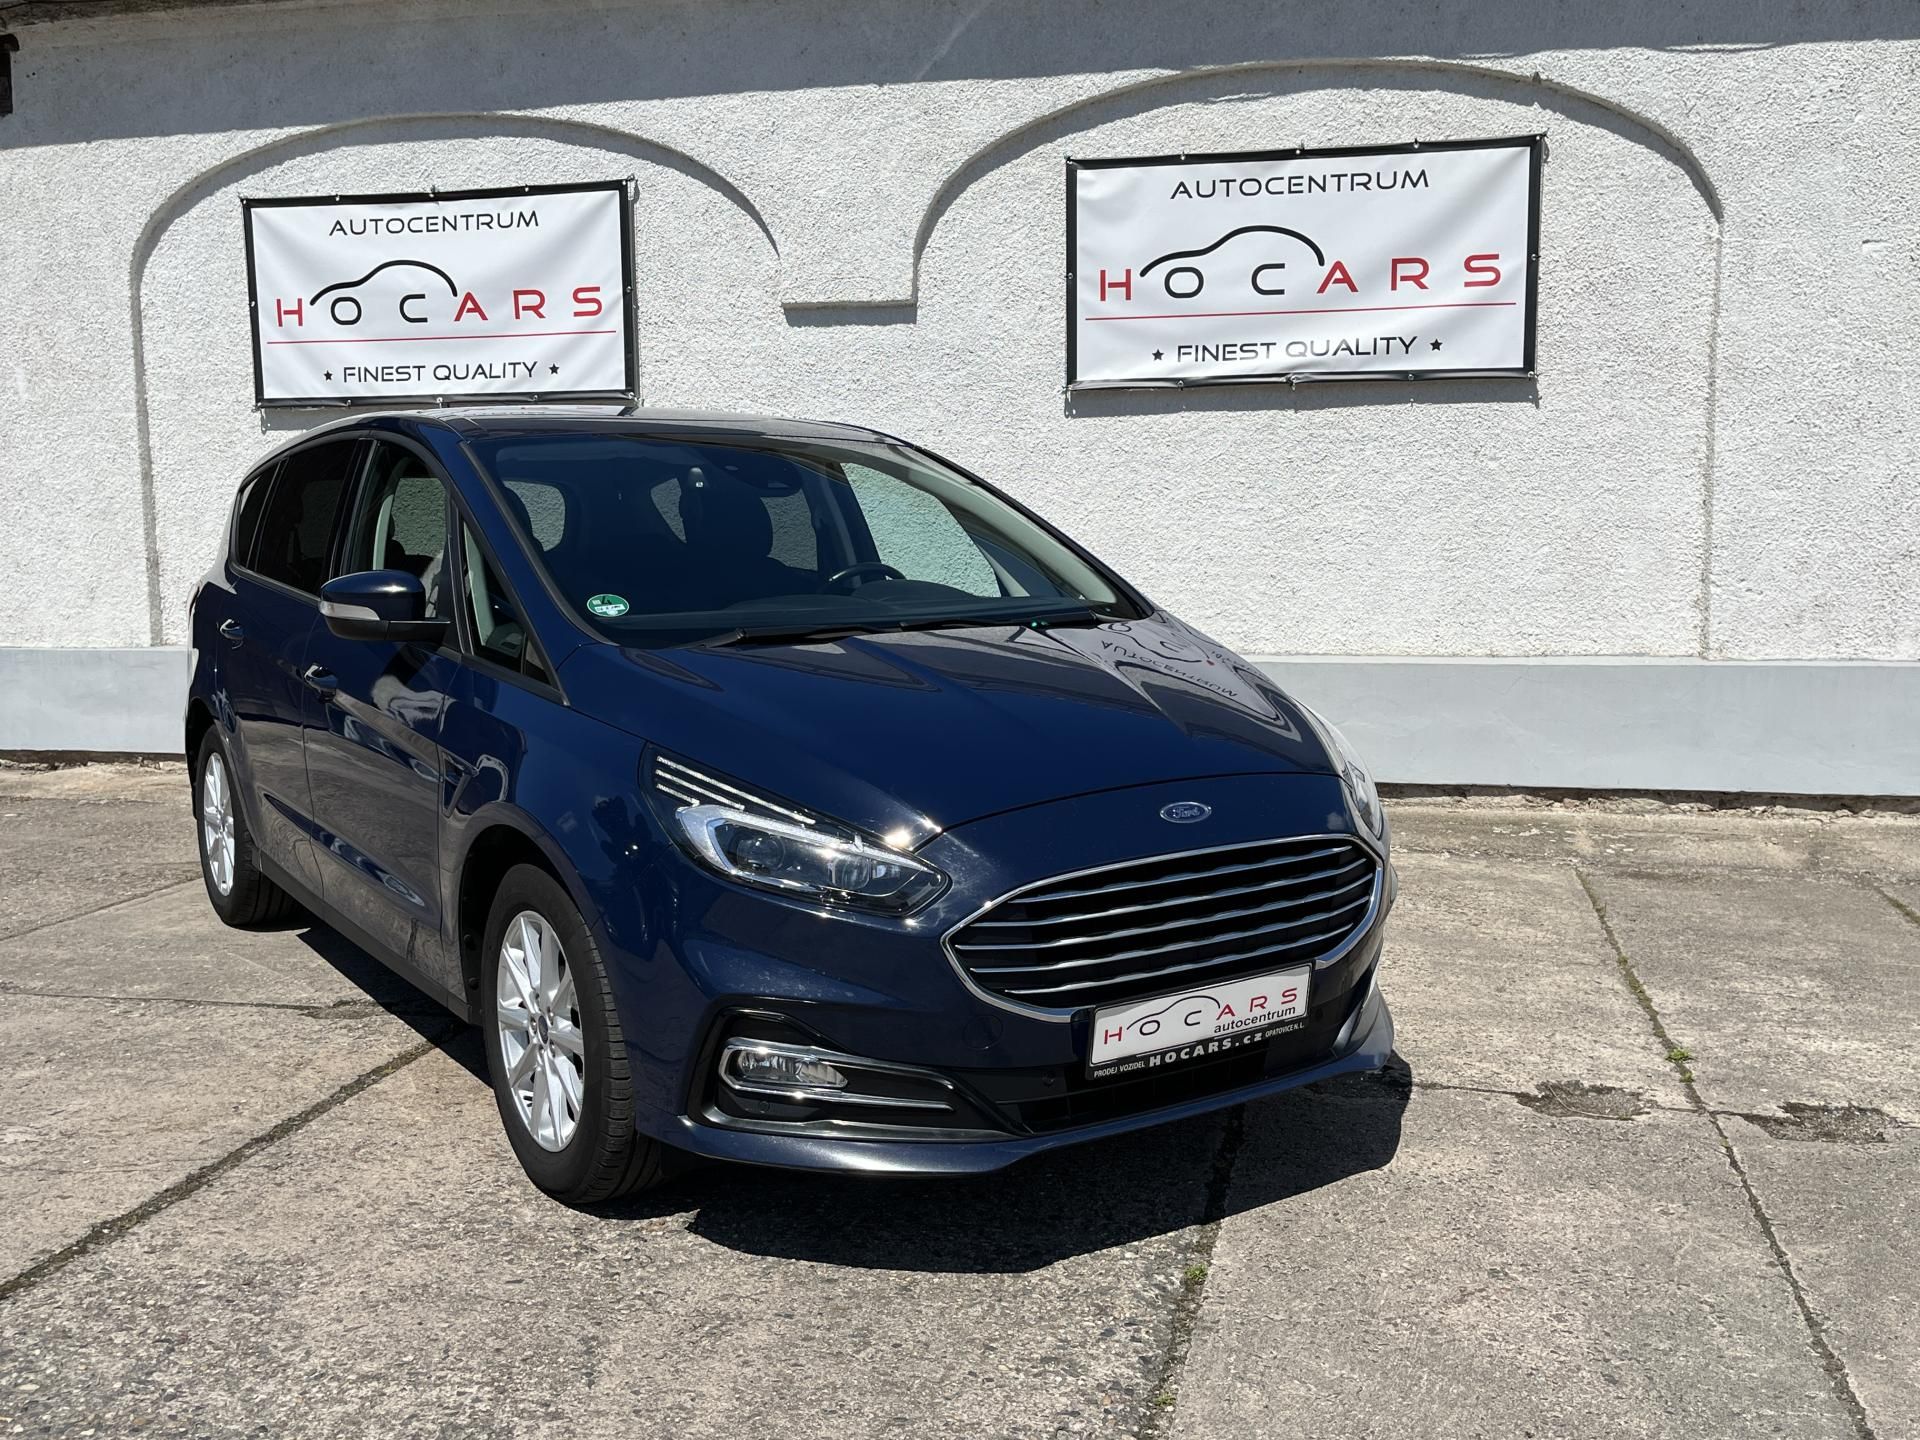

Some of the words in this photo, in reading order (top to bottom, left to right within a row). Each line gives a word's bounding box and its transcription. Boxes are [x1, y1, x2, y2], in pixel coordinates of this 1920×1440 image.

[1170, 169, 1429, 200] AUTOCENTRUM
[329, 210, 539, 237] AUTOCENTRUM
[1099, 253, 1501, 302] HOCARS
[276, 286, 602, 328] HOCARS
[1177, 342, 1277, 363] FINEST
[1285, 336, 1418, 358] QUALITY
[343, 365, 426, 383] FINEST
[433, 361, 538, 381] QUALITY
[1103, 987, 1298, 1045] HOCARS
[1213, 1006, 1296, 1034] autocentrum
[1094, 1066, 1118, 1078] PRODEJ
[1119, 1060, 1146, 1072] VOZIDEL
